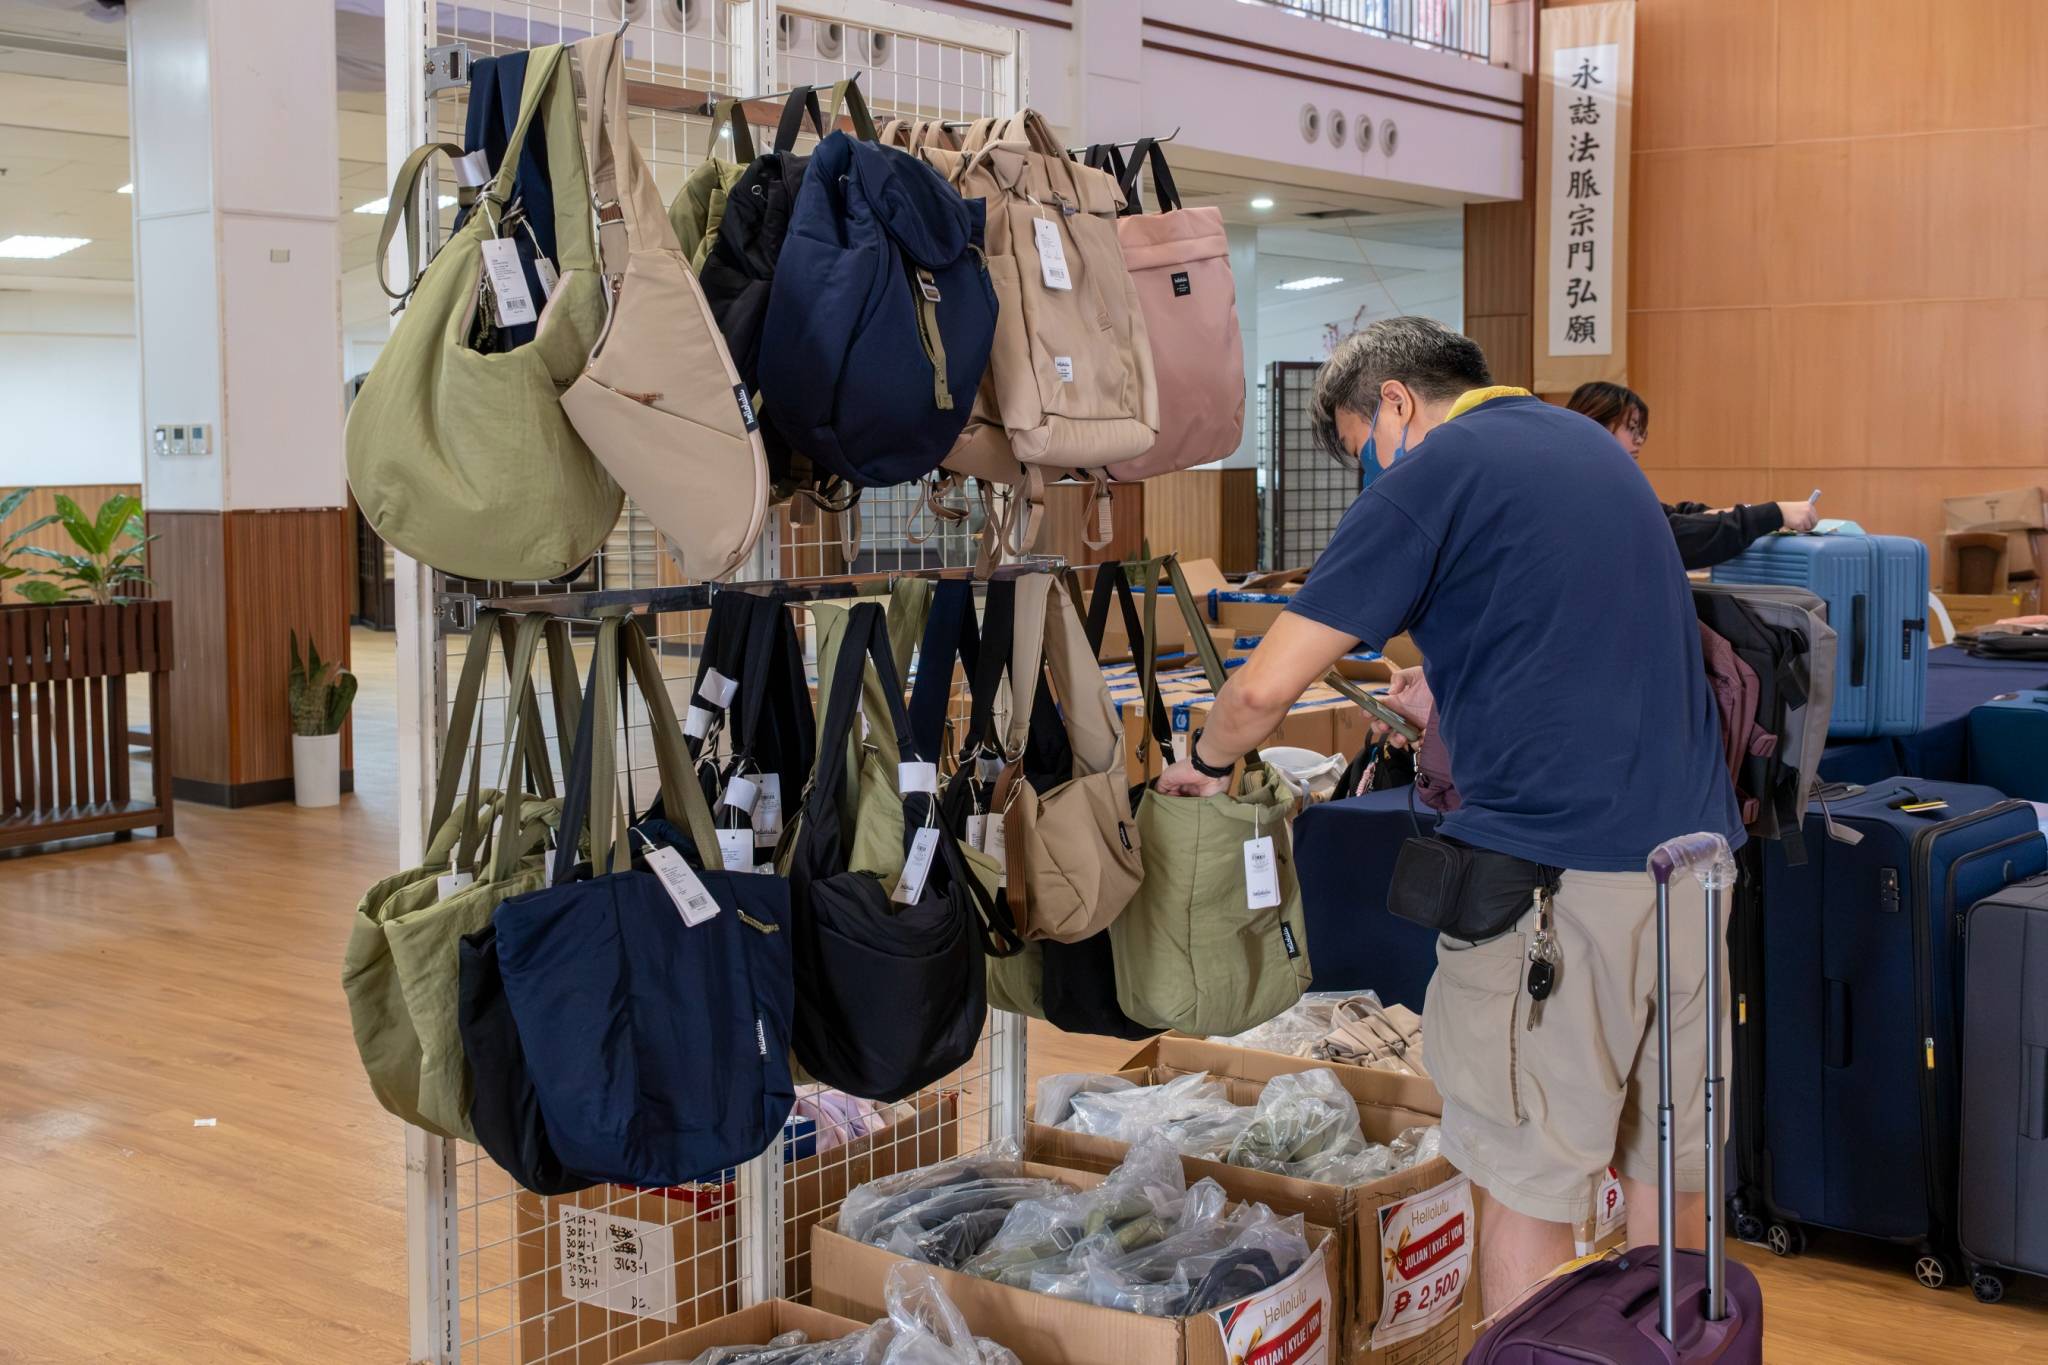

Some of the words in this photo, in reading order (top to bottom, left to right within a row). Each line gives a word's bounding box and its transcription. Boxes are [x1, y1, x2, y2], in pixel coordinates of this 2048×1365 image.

[1564, 57, 1603, 344] 永誌法脈宗門弘願
[1411, 1199, 1449, 1226] Hellolulu
[1404, 1246, 1428, 1271] JULIAN
[1432, 1233, 1448, 1255] KYLIE
[1451, 1223, 1463, 1241] VON
[1264, 1288, 1307, 1327] Hellolulu
[1417, 1268, 1460, 1312] 2,500
[1288, 1327, 1306, 1354] KYLIE
